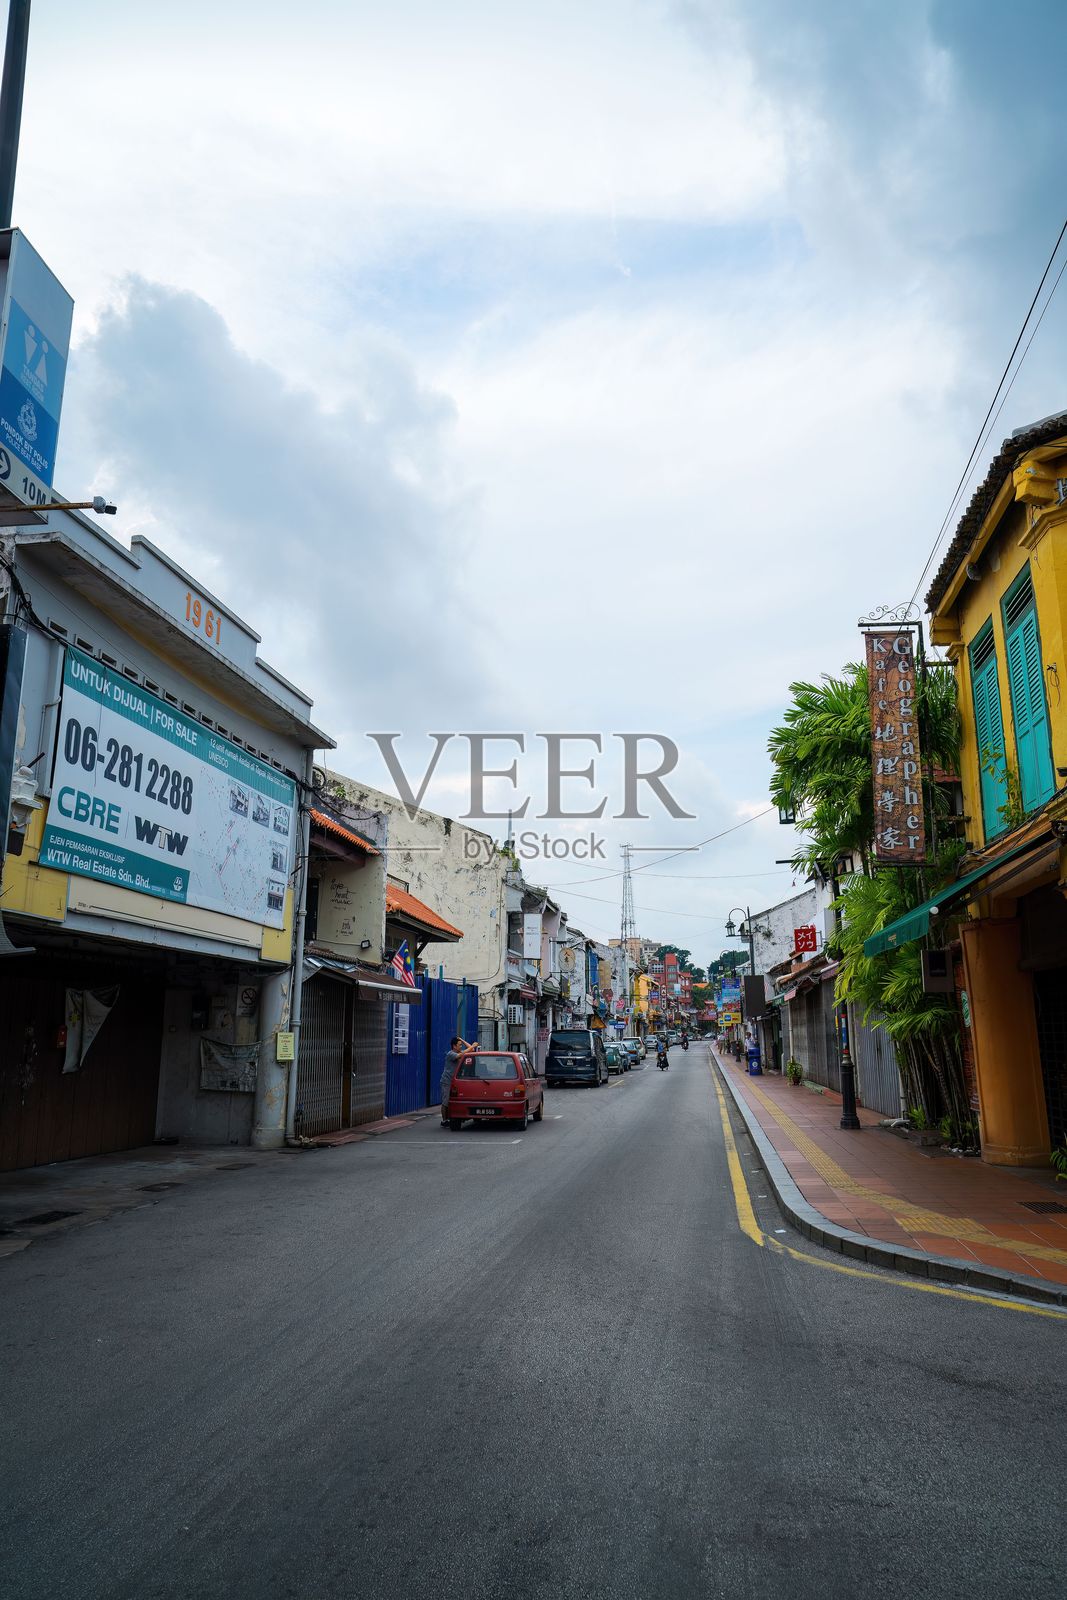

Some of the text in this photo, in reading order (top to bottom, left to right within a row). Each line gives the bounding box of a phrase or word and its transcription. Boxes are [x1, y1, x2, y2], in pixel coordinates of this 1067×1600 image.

[1, 417, 48, 469] PONDOK BIT POLIS
[6, 434, 42, 472] POLICE BEAT BASE
[22, 476, 46, 505] 10M
[185, 592, 222, 645] 1961
[872, 638, 888, 710] Kafe
[71, 660, 198, 746] UNTUK DIJUAL FOR SALE
[208, 750, 229, 769] UNESCO
[57, 786, 189, 856] CBRE WTW
[47, 848, 151, 889] WTW Real Estate Sdn. Bhd.
[49, 835, 126, 864] EJEN PEMASARAN EKSKLUSIF
[797, 931, 813, 941] メイ
[797, 940, 814, 949] ソウ
[465, 1057, 473, 1065] P
